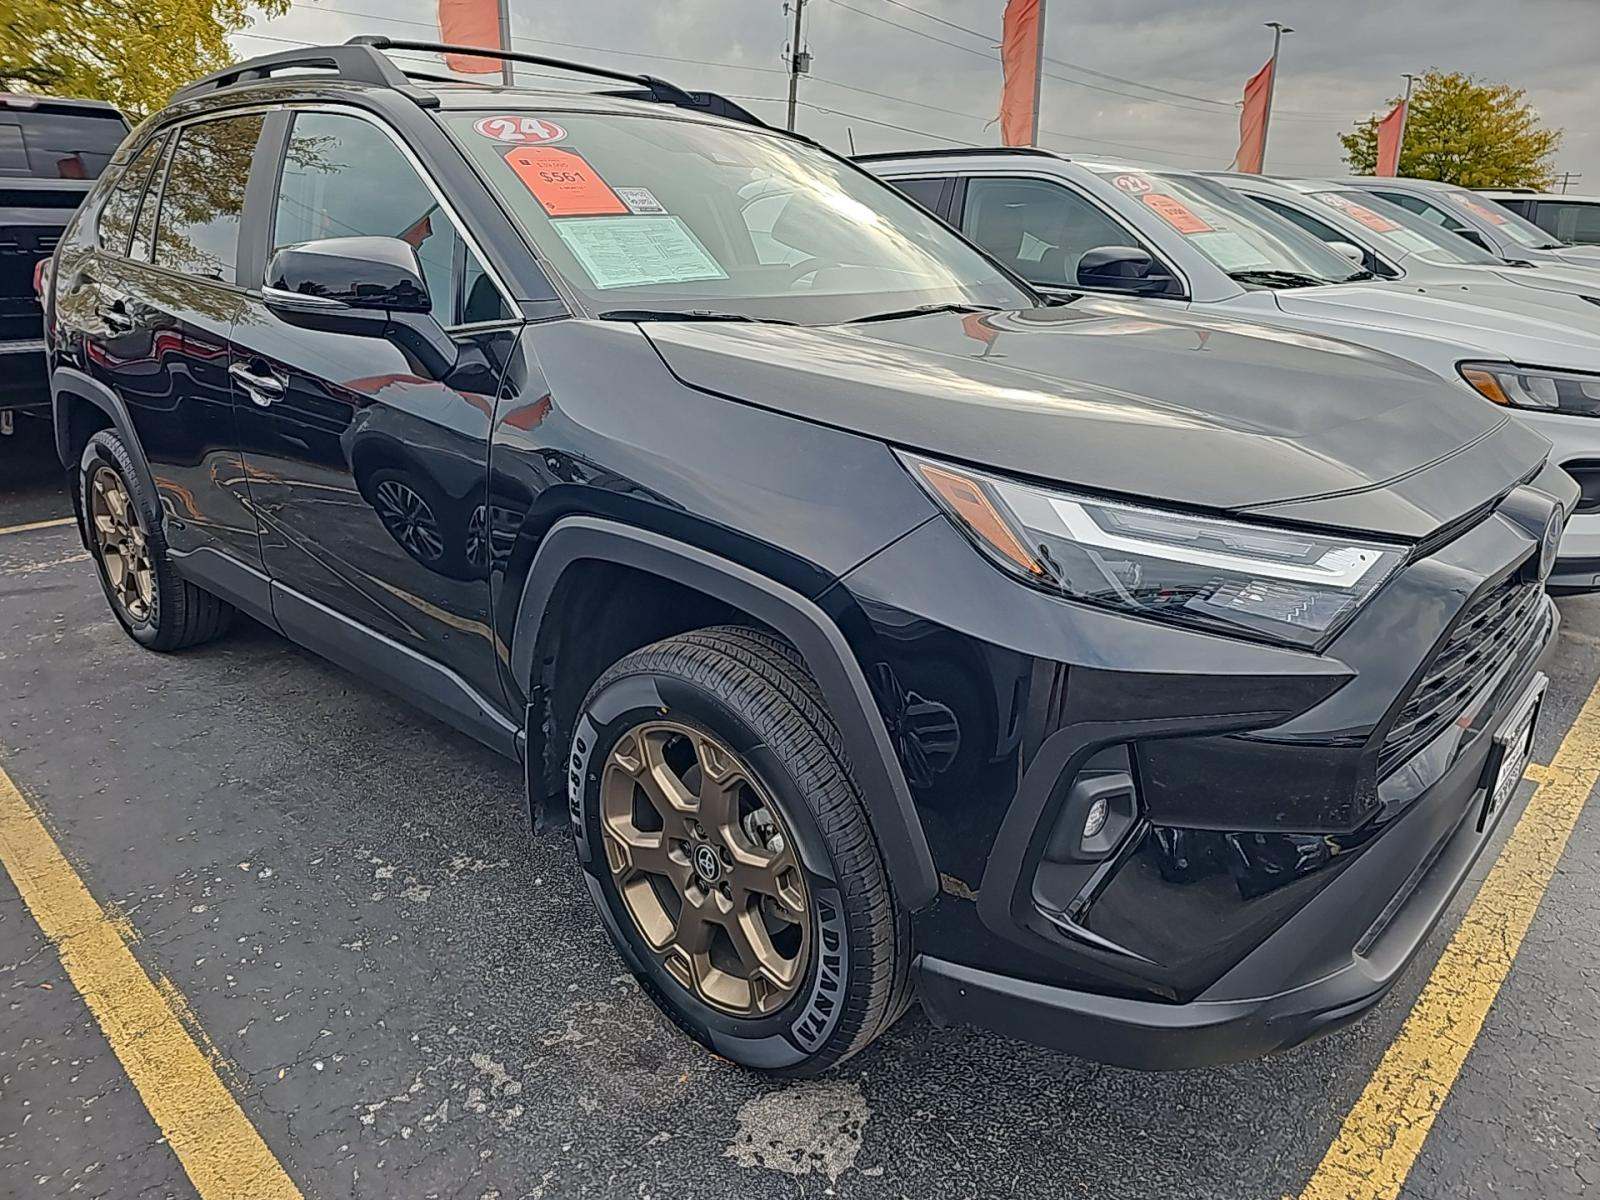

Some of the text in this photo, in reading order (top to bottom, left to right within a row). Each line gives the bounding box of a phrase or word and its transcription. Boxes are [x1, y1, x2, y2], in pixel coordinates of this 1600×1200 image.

[490, 119, 550, 140] 24
[540, 171, 586, 183] $561
[796, 896, 841, 1043] ADVANTA
